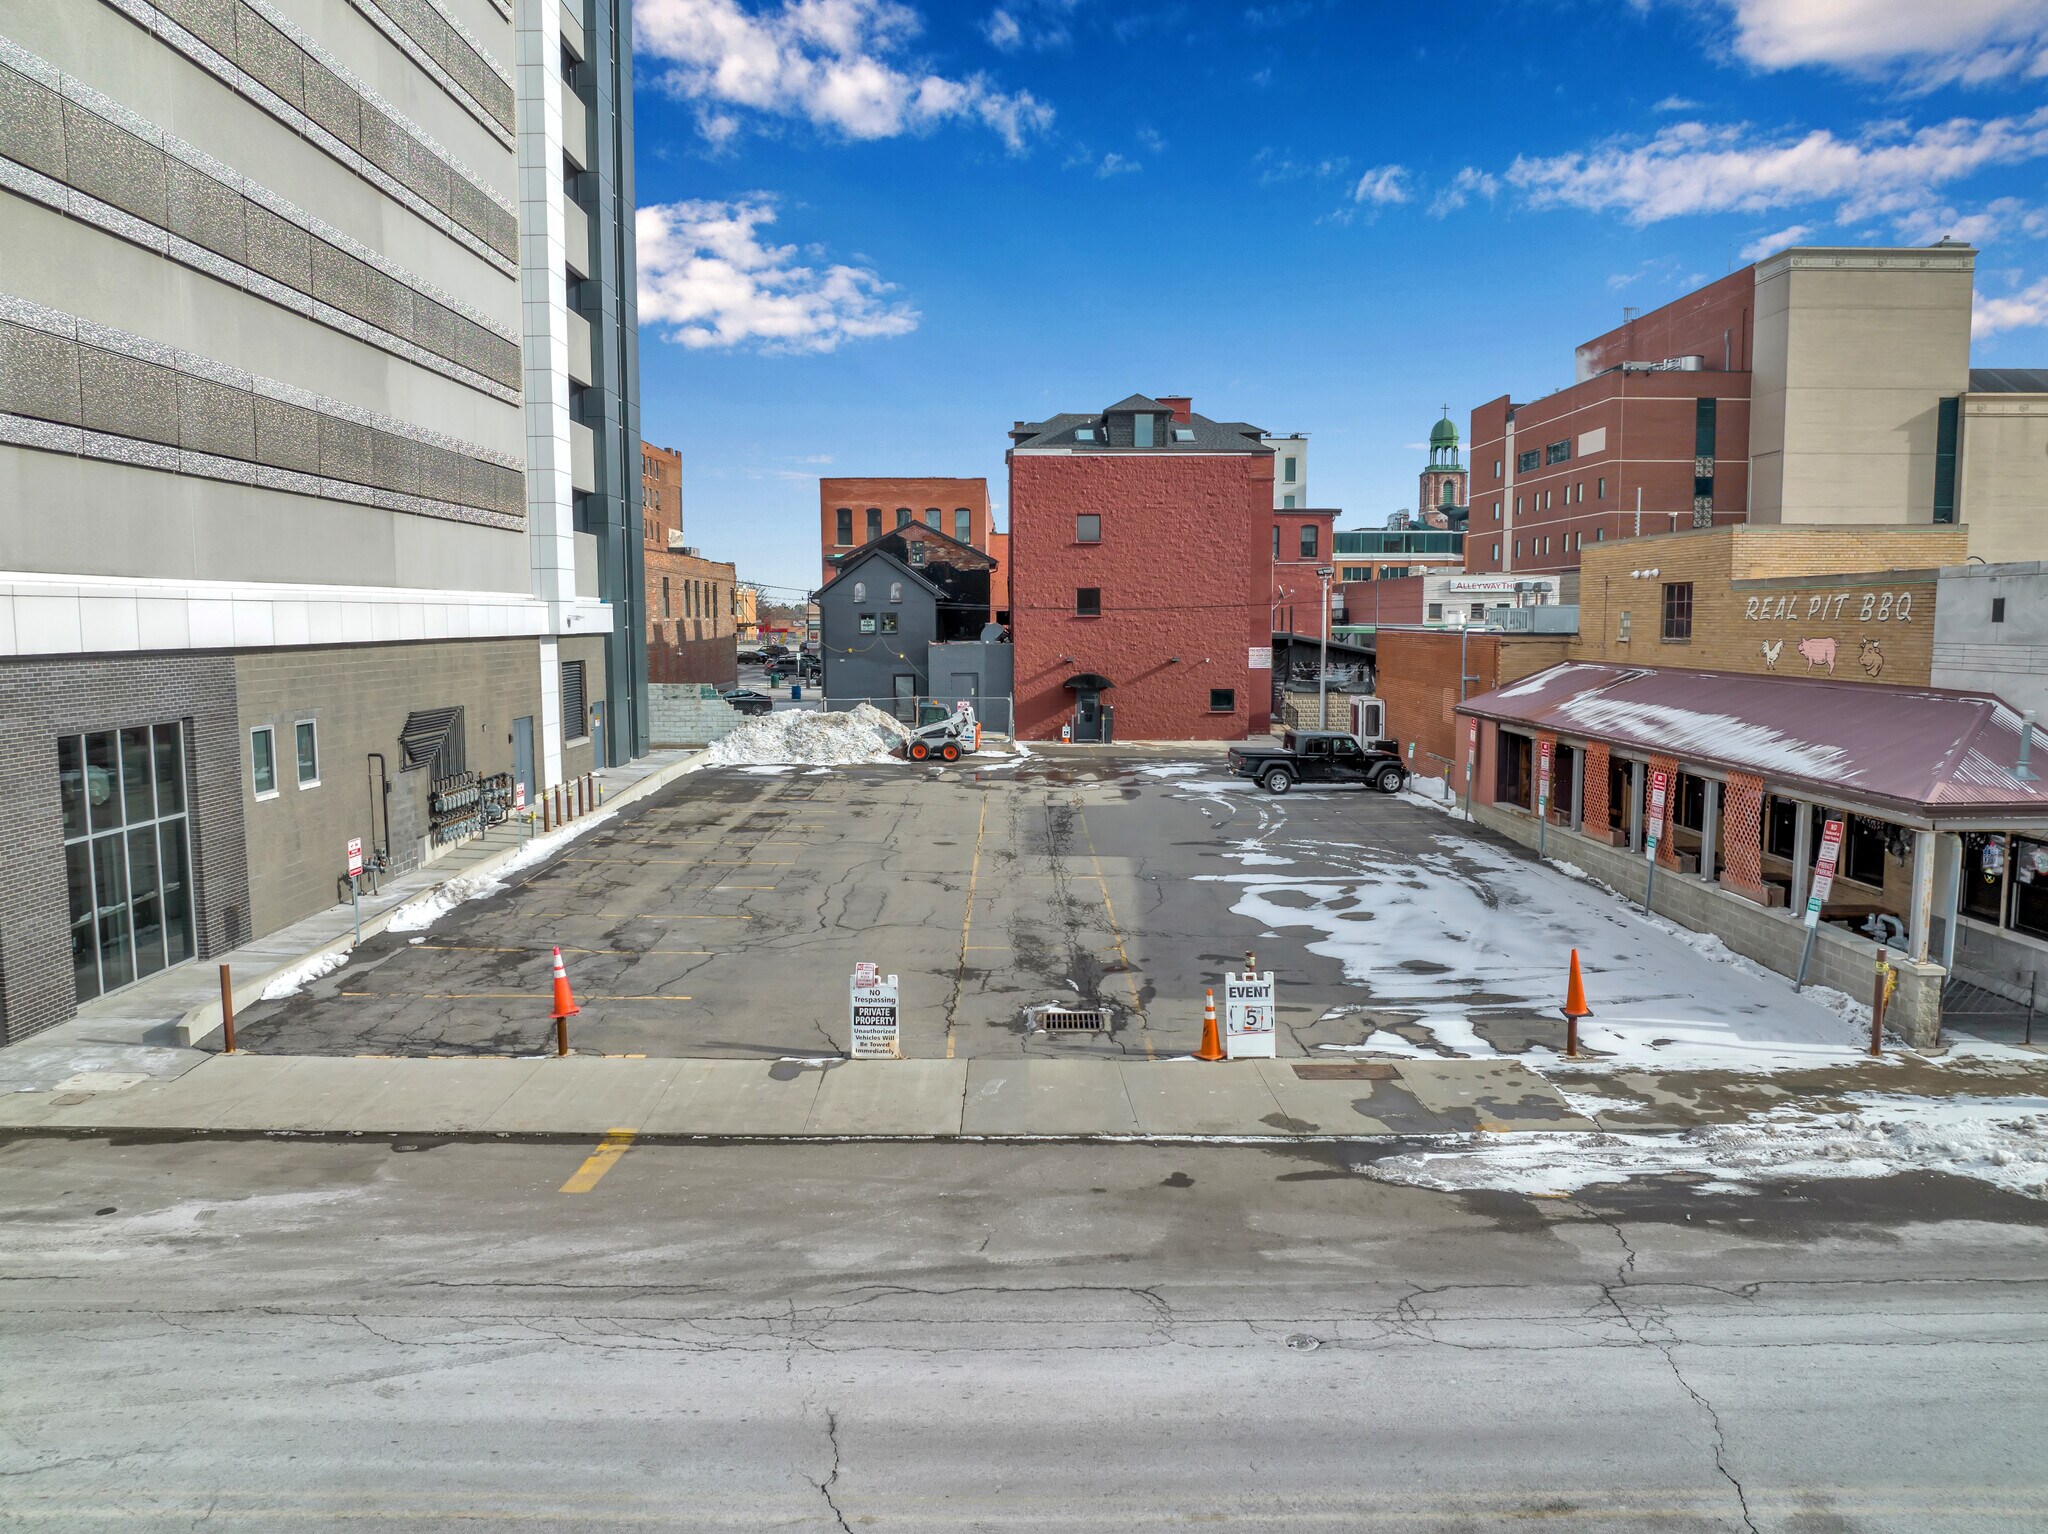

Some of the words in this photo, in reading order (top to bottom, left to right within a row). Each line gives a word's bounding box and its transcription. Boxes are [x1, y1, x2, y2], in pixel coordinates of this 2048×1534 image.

[1456, 582, 1501, 590] ALLEYWAY
[1745, 595, 1798, 621] REAL
[1807, 593, 1850, 621] PIT
[1859, 592, 1913, 623] BBQ
[1229, 986, 1270, 998] EVENT
[854, 996, 896, 1004] Trespassing
[859, 1007, 890, 1016] PRIVATE
[855, 1016, 895, 1025] PROPERTY
[1246, 1009, 1257, 1026] 5
